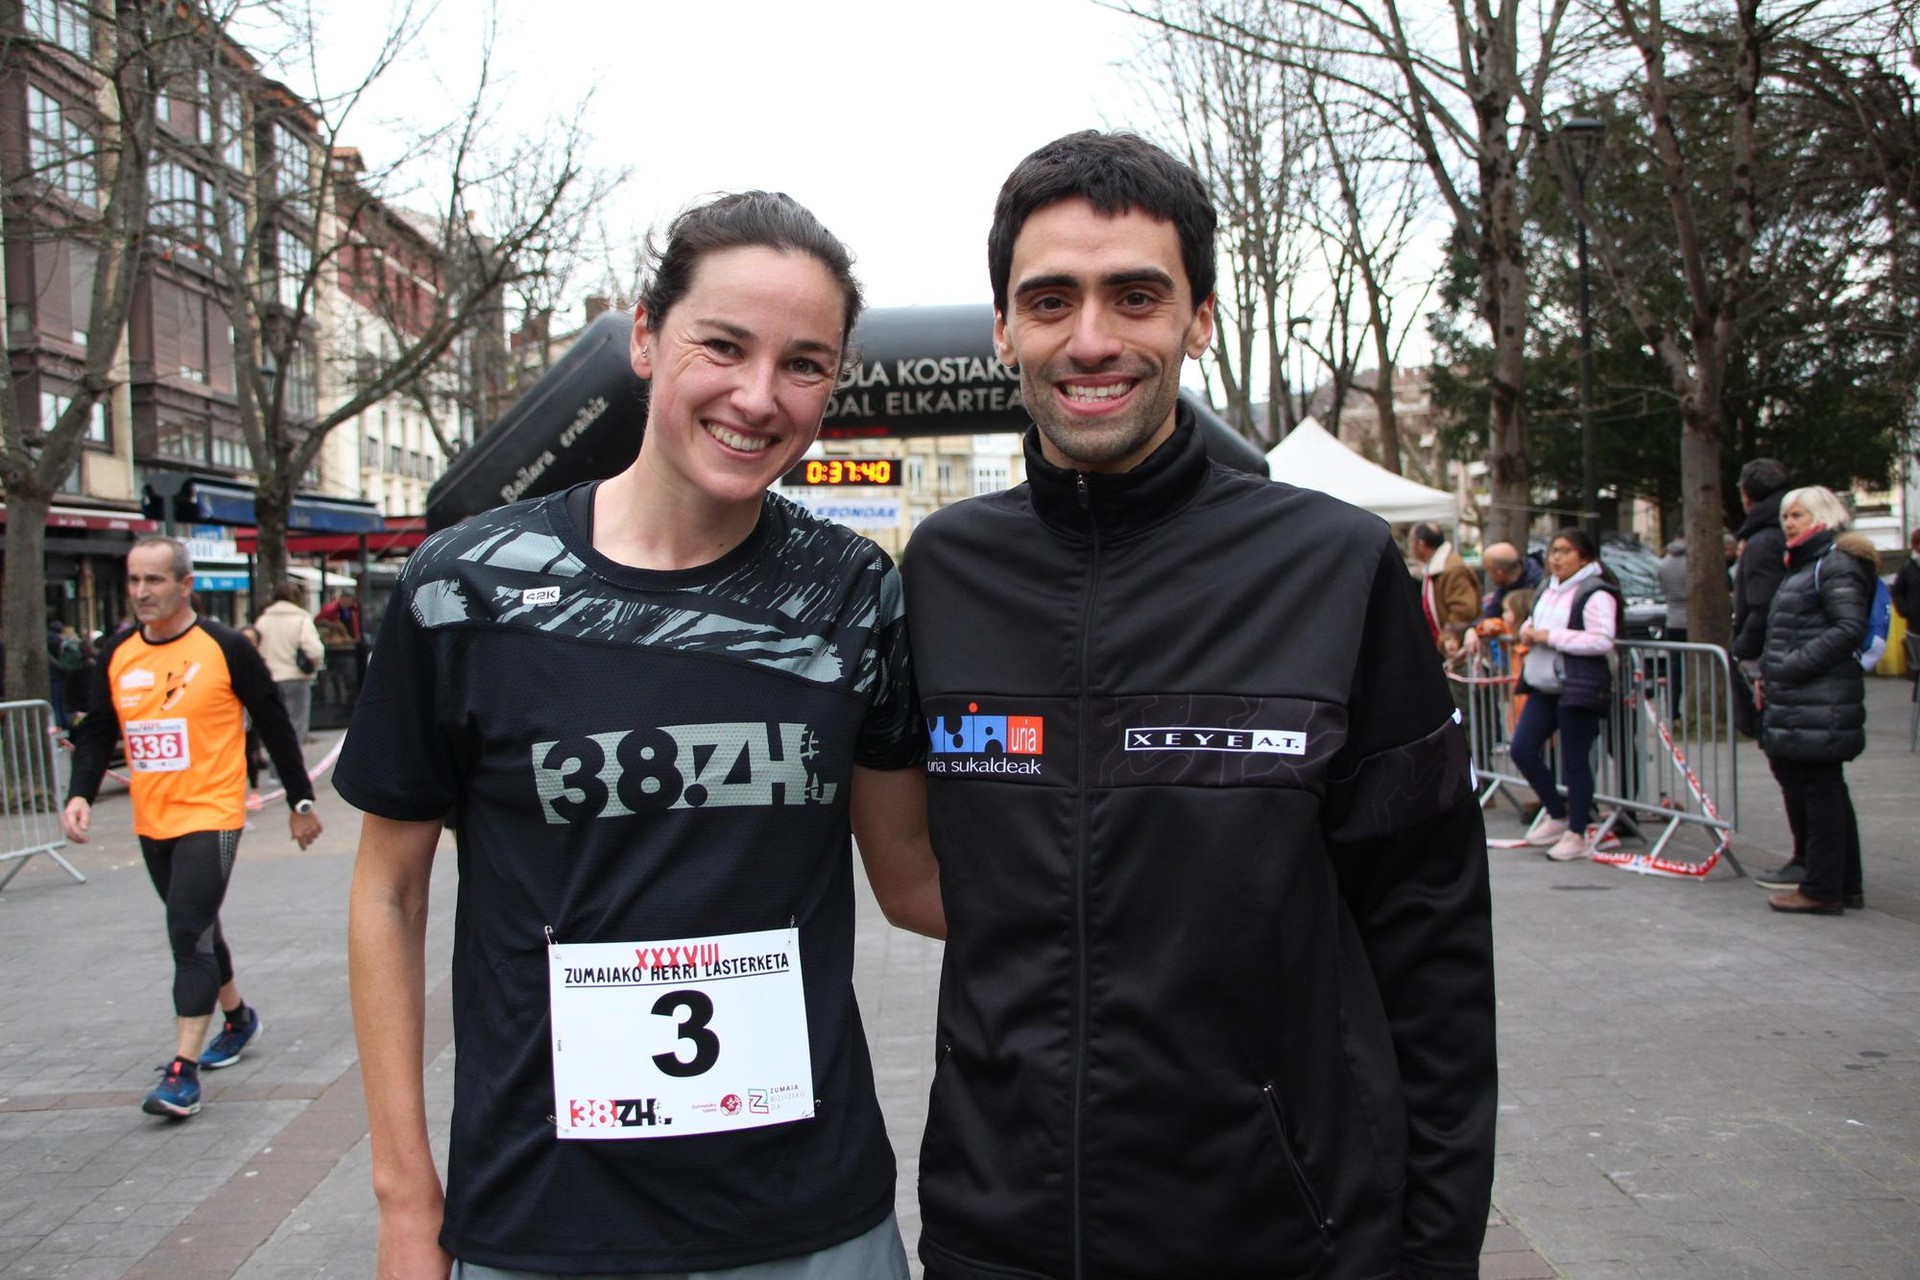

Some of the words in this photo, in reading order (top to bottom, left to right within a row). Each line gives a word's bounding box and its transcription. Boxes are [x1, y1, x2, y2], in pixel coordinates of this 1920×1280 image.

[885, 386, 1024, 417] ELKARTEA
[806, 461, 890, 484] 0:37:40
[526, 590, 556, 601] 42K
[130, 734, 179, 759] 336
[1011, 718, 1037, 752] uria
[1257, 737, 1300, 749] A.T.
[951, 757, 1042, 775] sukaldeak
[564, 966, 642, 984] ZUMAIAKO
[651, 963, 697, 981] HERRI
[705, 952, 790, 977] LASTERKETA
[635, 943, 719, 970] XXXVIII
[651, 989, 720, 1078] 3
[770, 1084, 799, 1094] ZUMAIA
